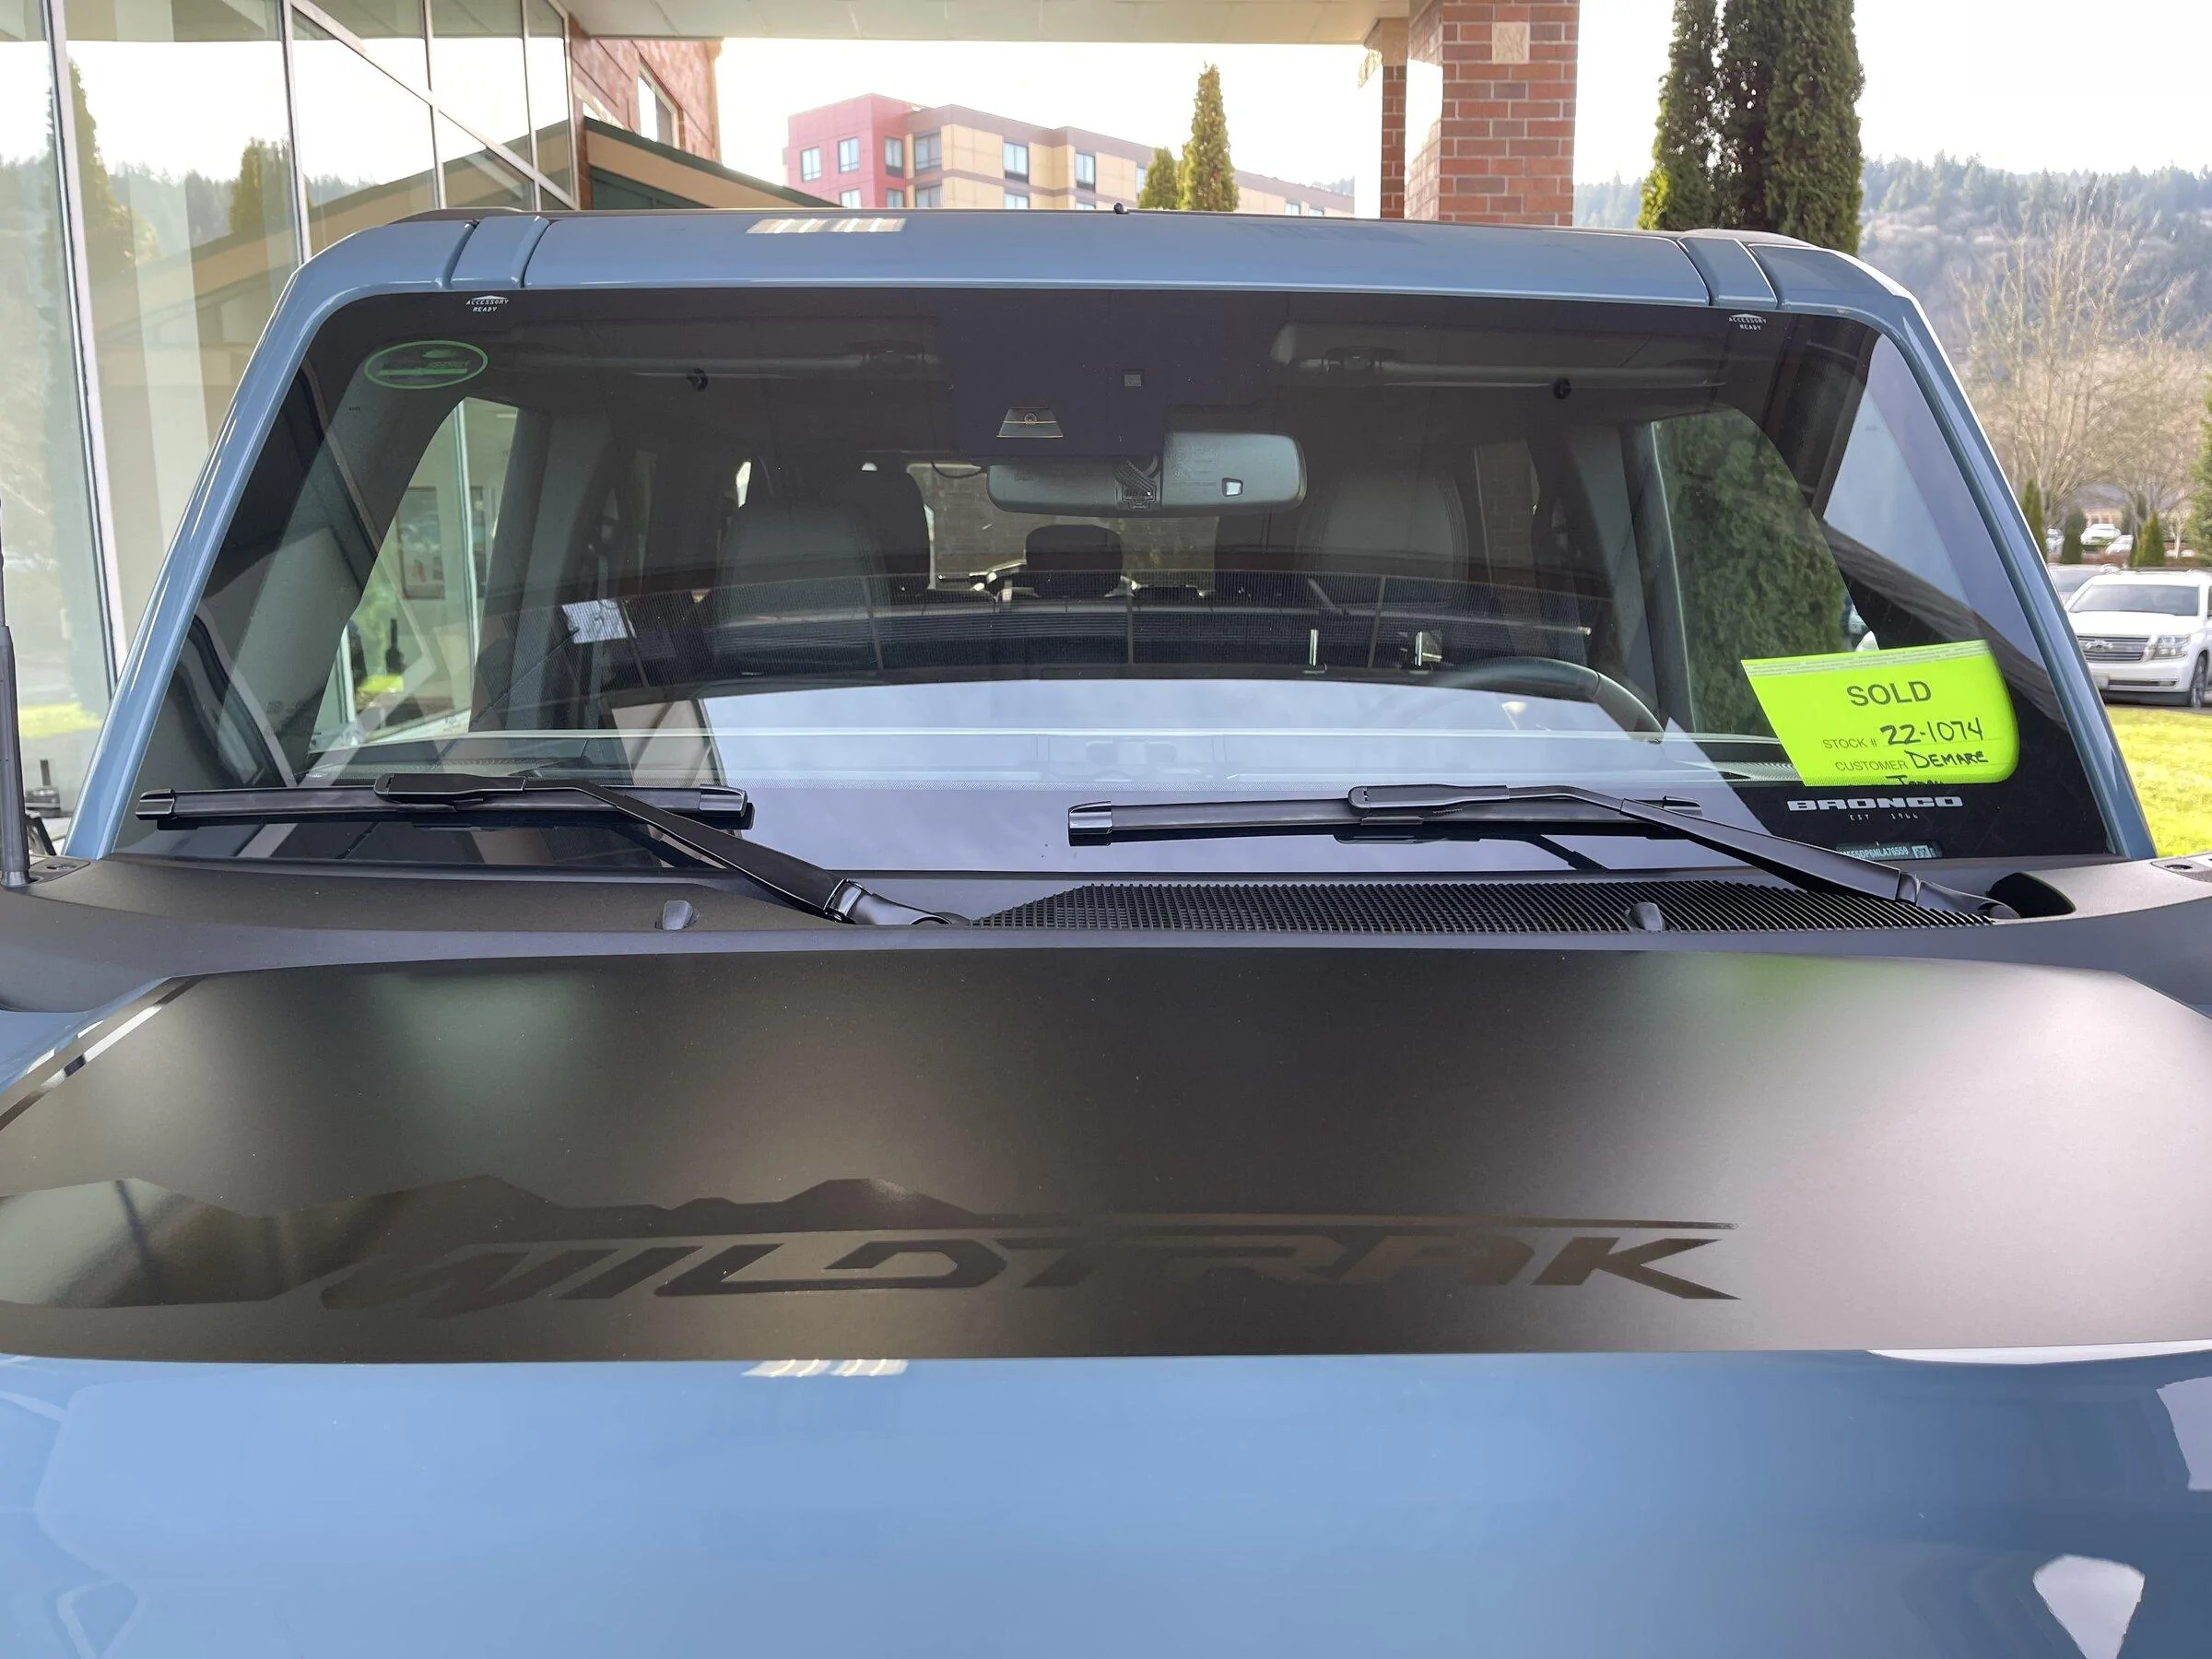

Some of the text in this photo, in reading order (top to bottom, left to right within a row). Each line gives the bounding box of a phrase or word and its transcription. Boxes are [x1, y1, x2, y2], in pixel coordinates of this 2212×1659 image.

[1846, 680, 1932, 707] SOLD
[1822, 717, 1984, 749] STOCK # 22-1074
[1835, 759, 1909, 772] CUSTOMER
[1786, 795, 1964, 812] BRONCO
[321, 1234, 1742, 1321] WILDTRAK
